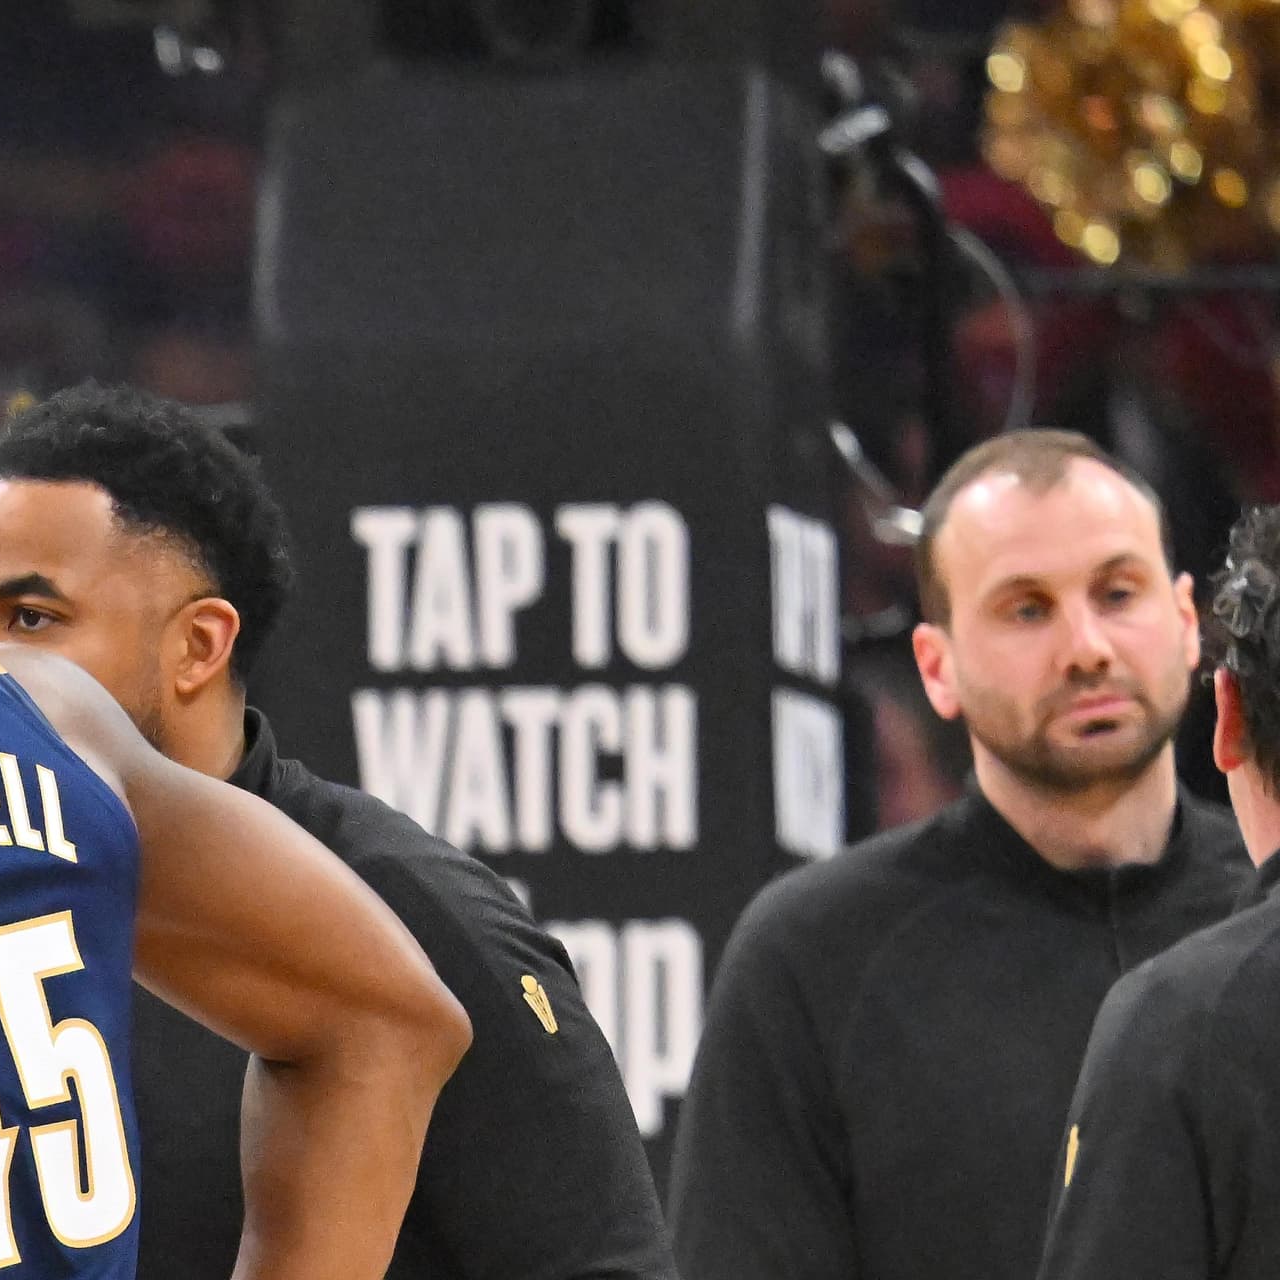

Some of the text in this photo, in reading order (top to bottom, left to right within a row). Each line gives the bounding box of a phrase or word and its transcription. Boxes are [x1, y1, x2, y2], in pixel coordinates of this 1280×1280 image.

[348, 502, 547, 672] TAP
[554, 500, 693, 671] TO
[350, 681, 701, 853] WATCH
[503, 877, 704, 1138] pp
